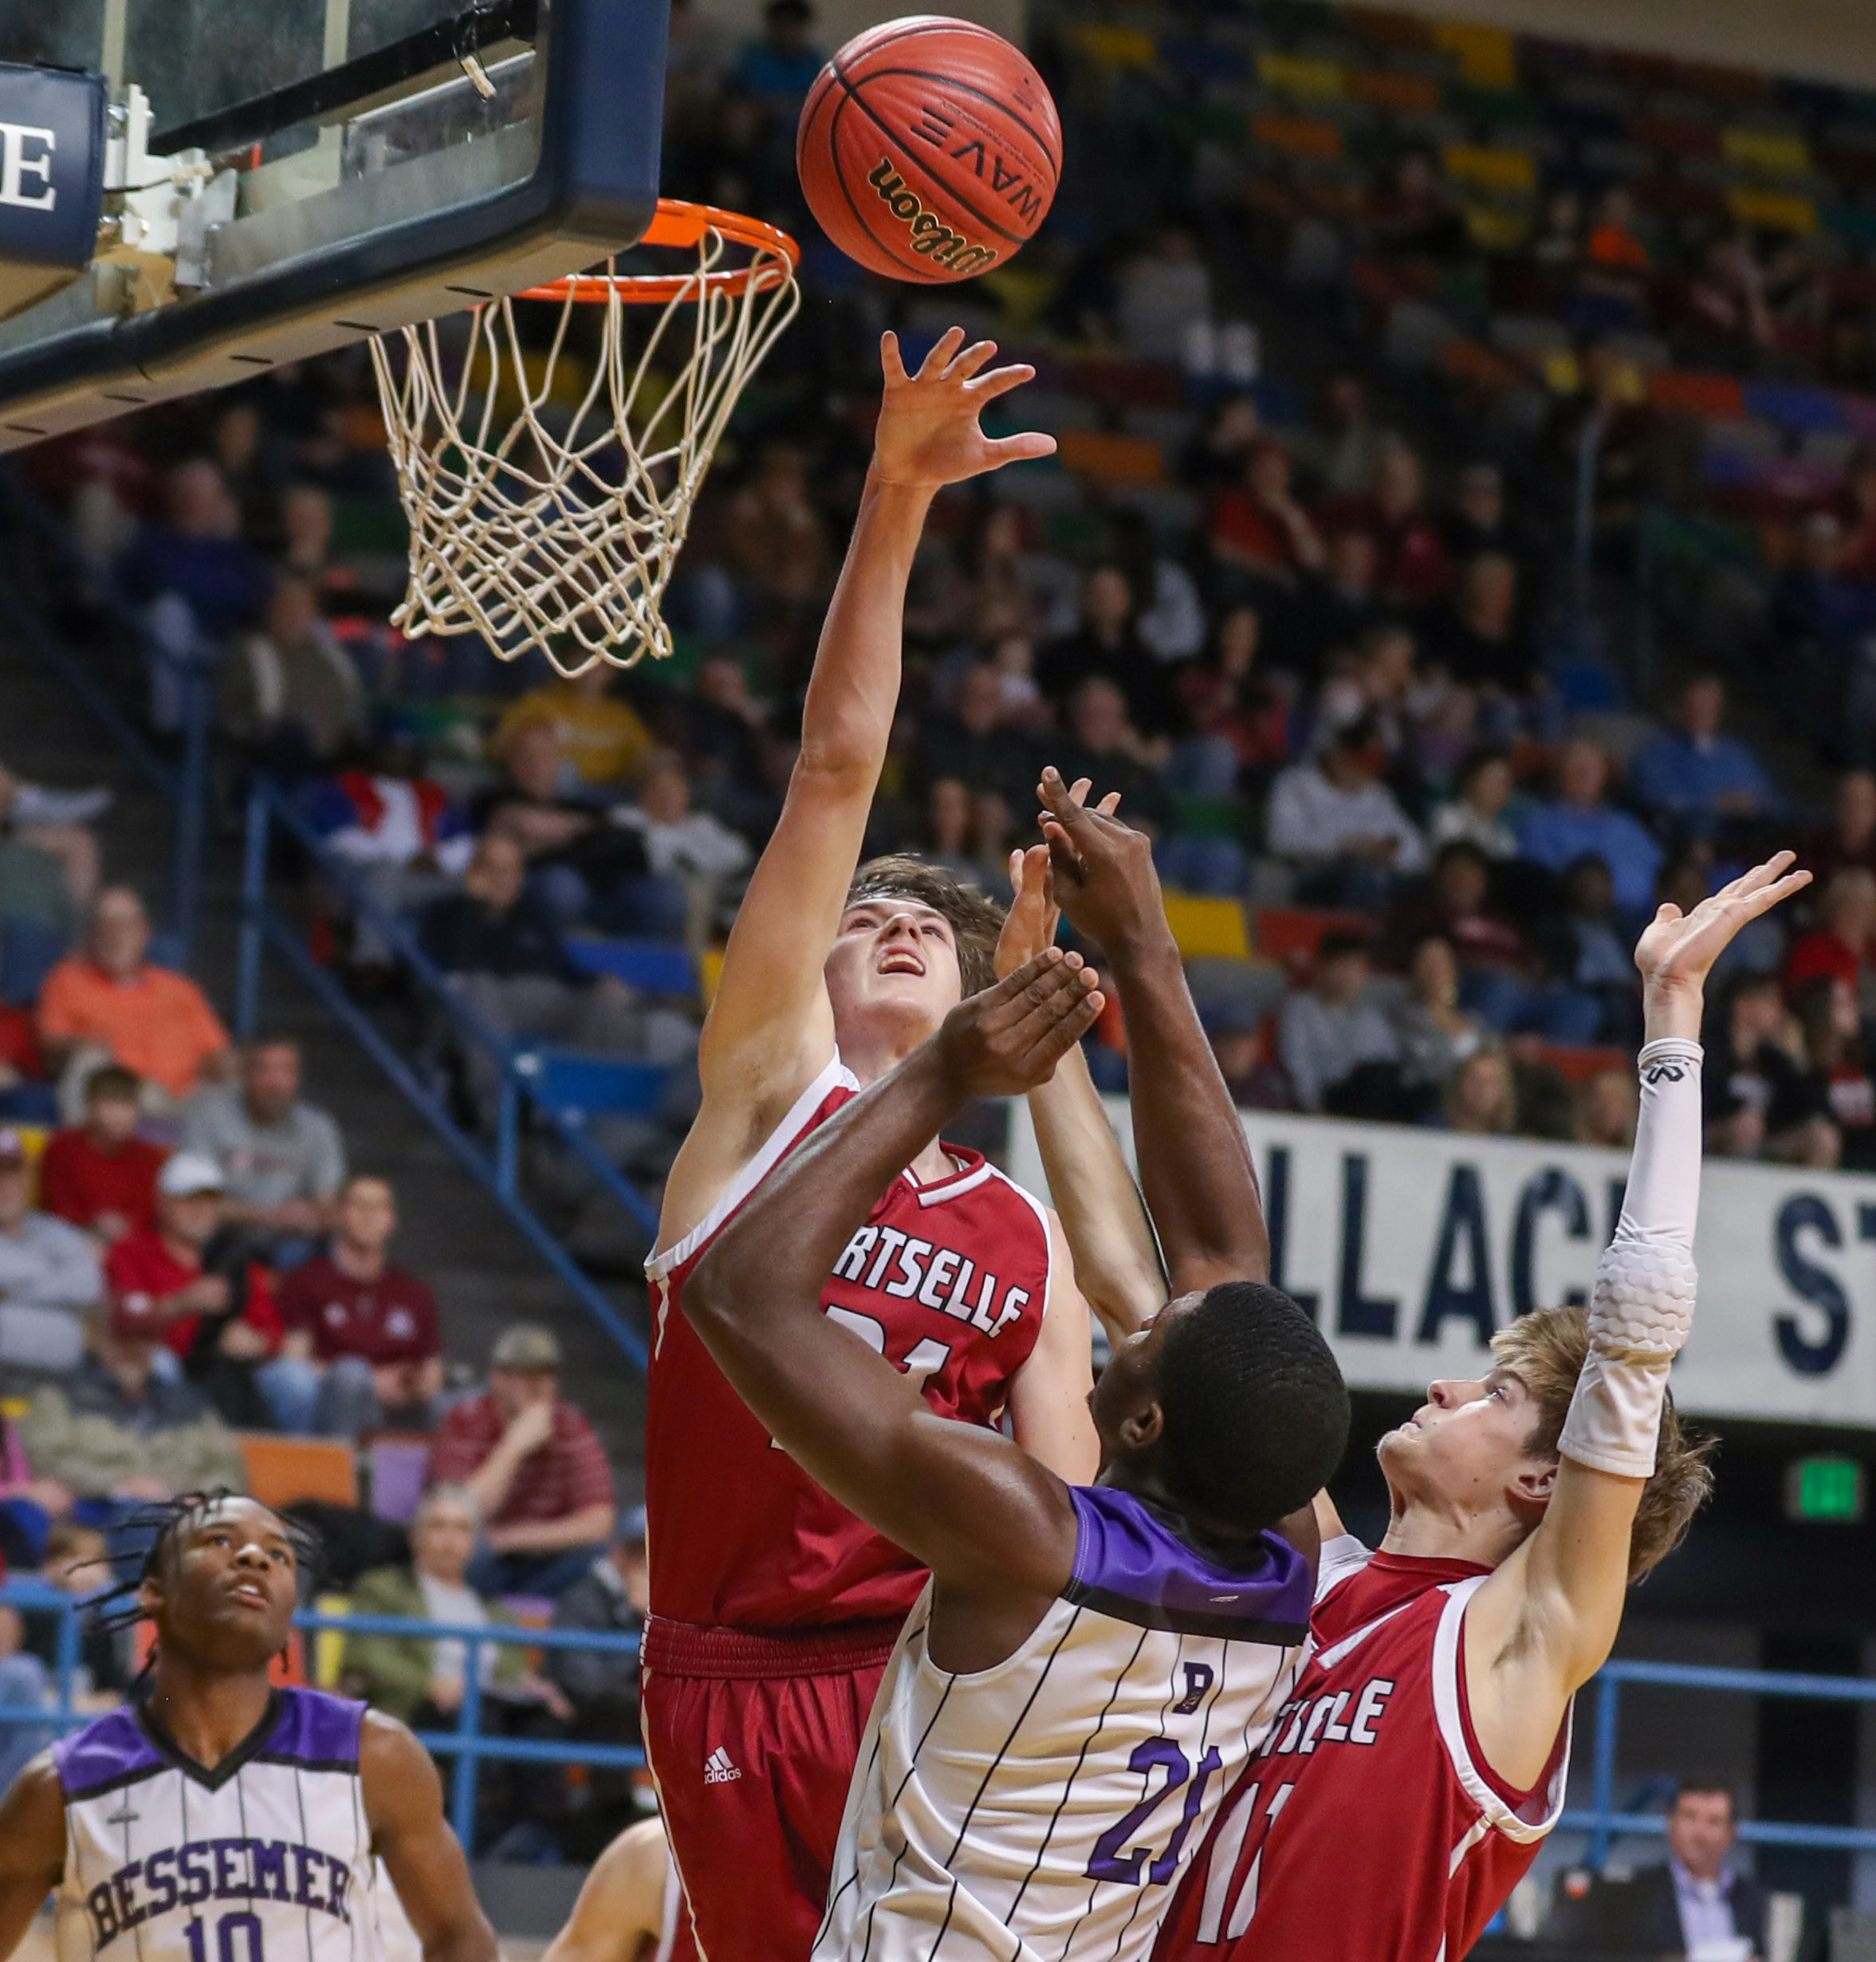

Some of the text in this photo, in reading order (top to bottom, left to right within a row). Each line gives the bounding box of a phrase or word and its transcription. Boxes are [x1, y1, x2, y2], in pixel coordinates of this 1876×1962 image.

[868, 157, 997, 274] Wilson
[910, 106, 1043, 226] WAVE
[1082, 1736, 1221, 1886] 21
[88, 1837, 351, 1952] BESSEMER
